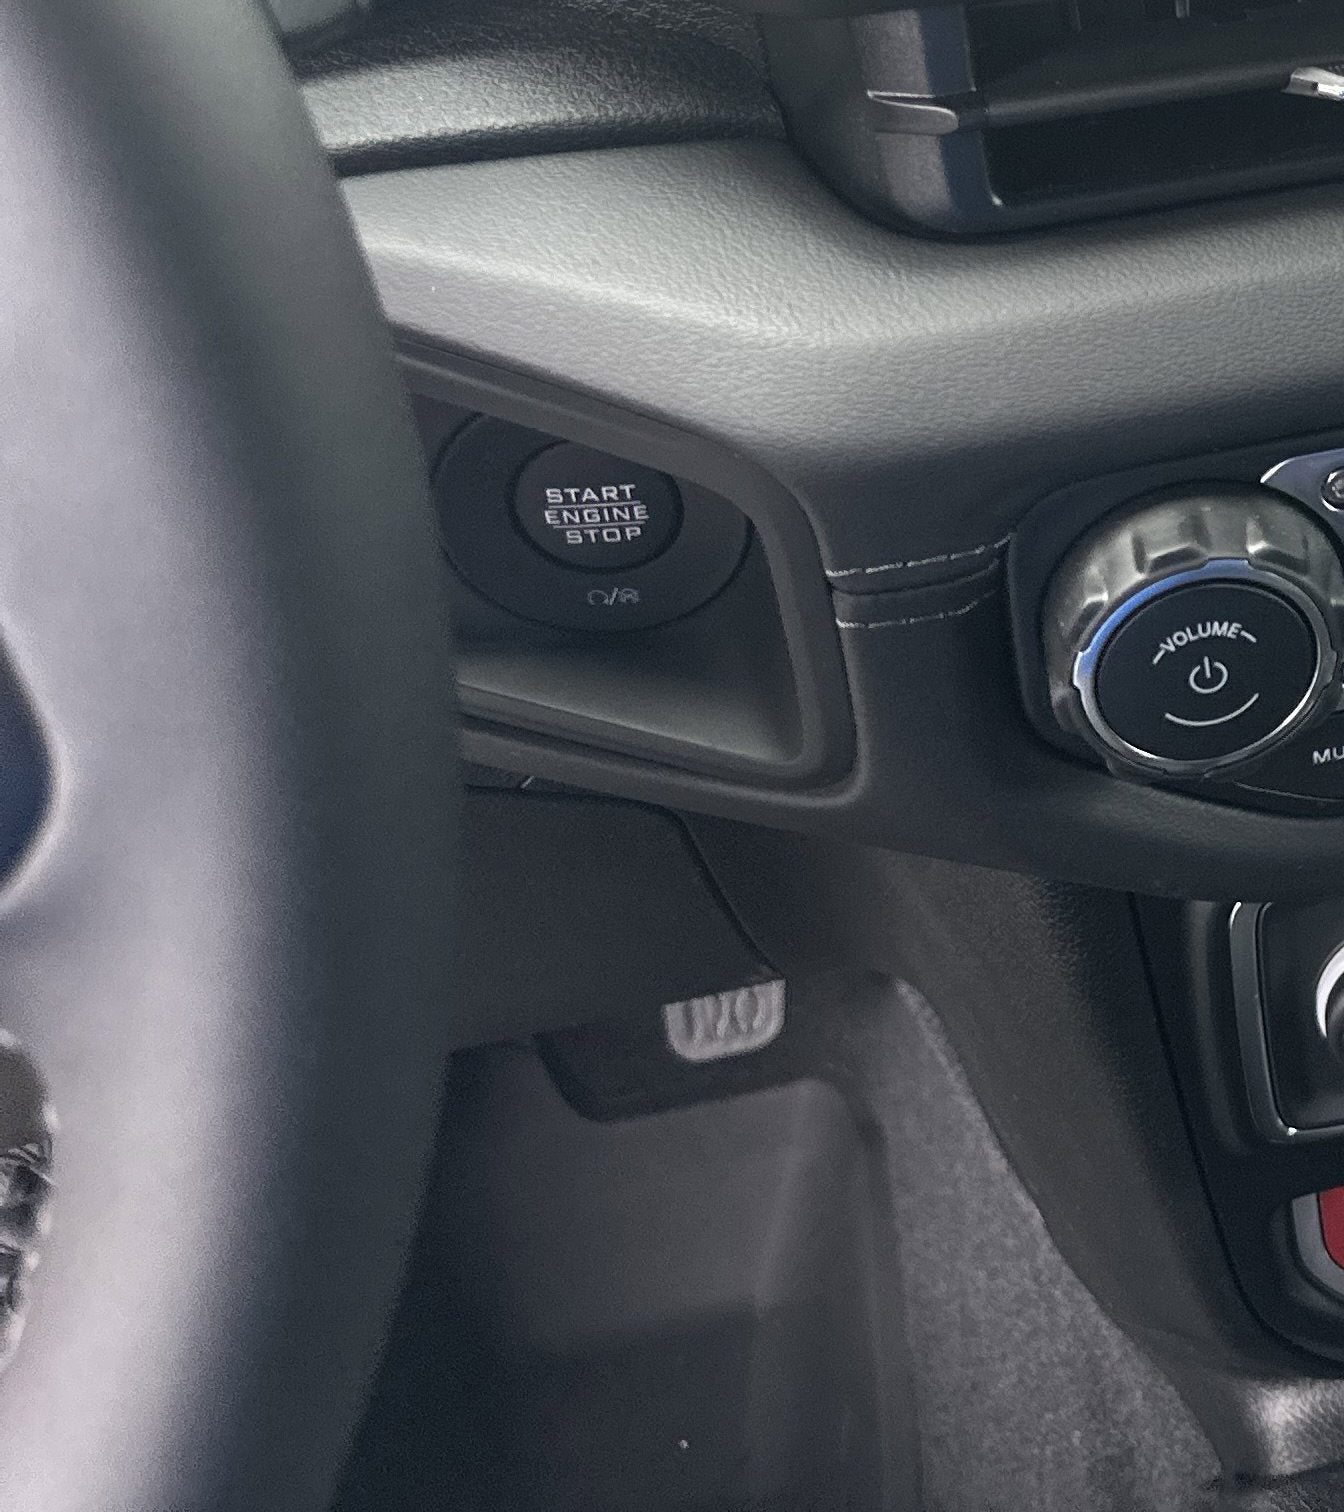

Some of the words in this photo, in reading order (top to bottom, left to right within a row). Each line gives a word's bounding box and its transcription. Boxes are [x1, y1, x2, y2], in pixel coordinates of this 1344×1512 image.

[545, 483, 636, 504] START
[543, 504, 650, 526] ENGINE
[565, 526, 642, 545] STOP
[1159, 622, 1244, 654] VOLUME
